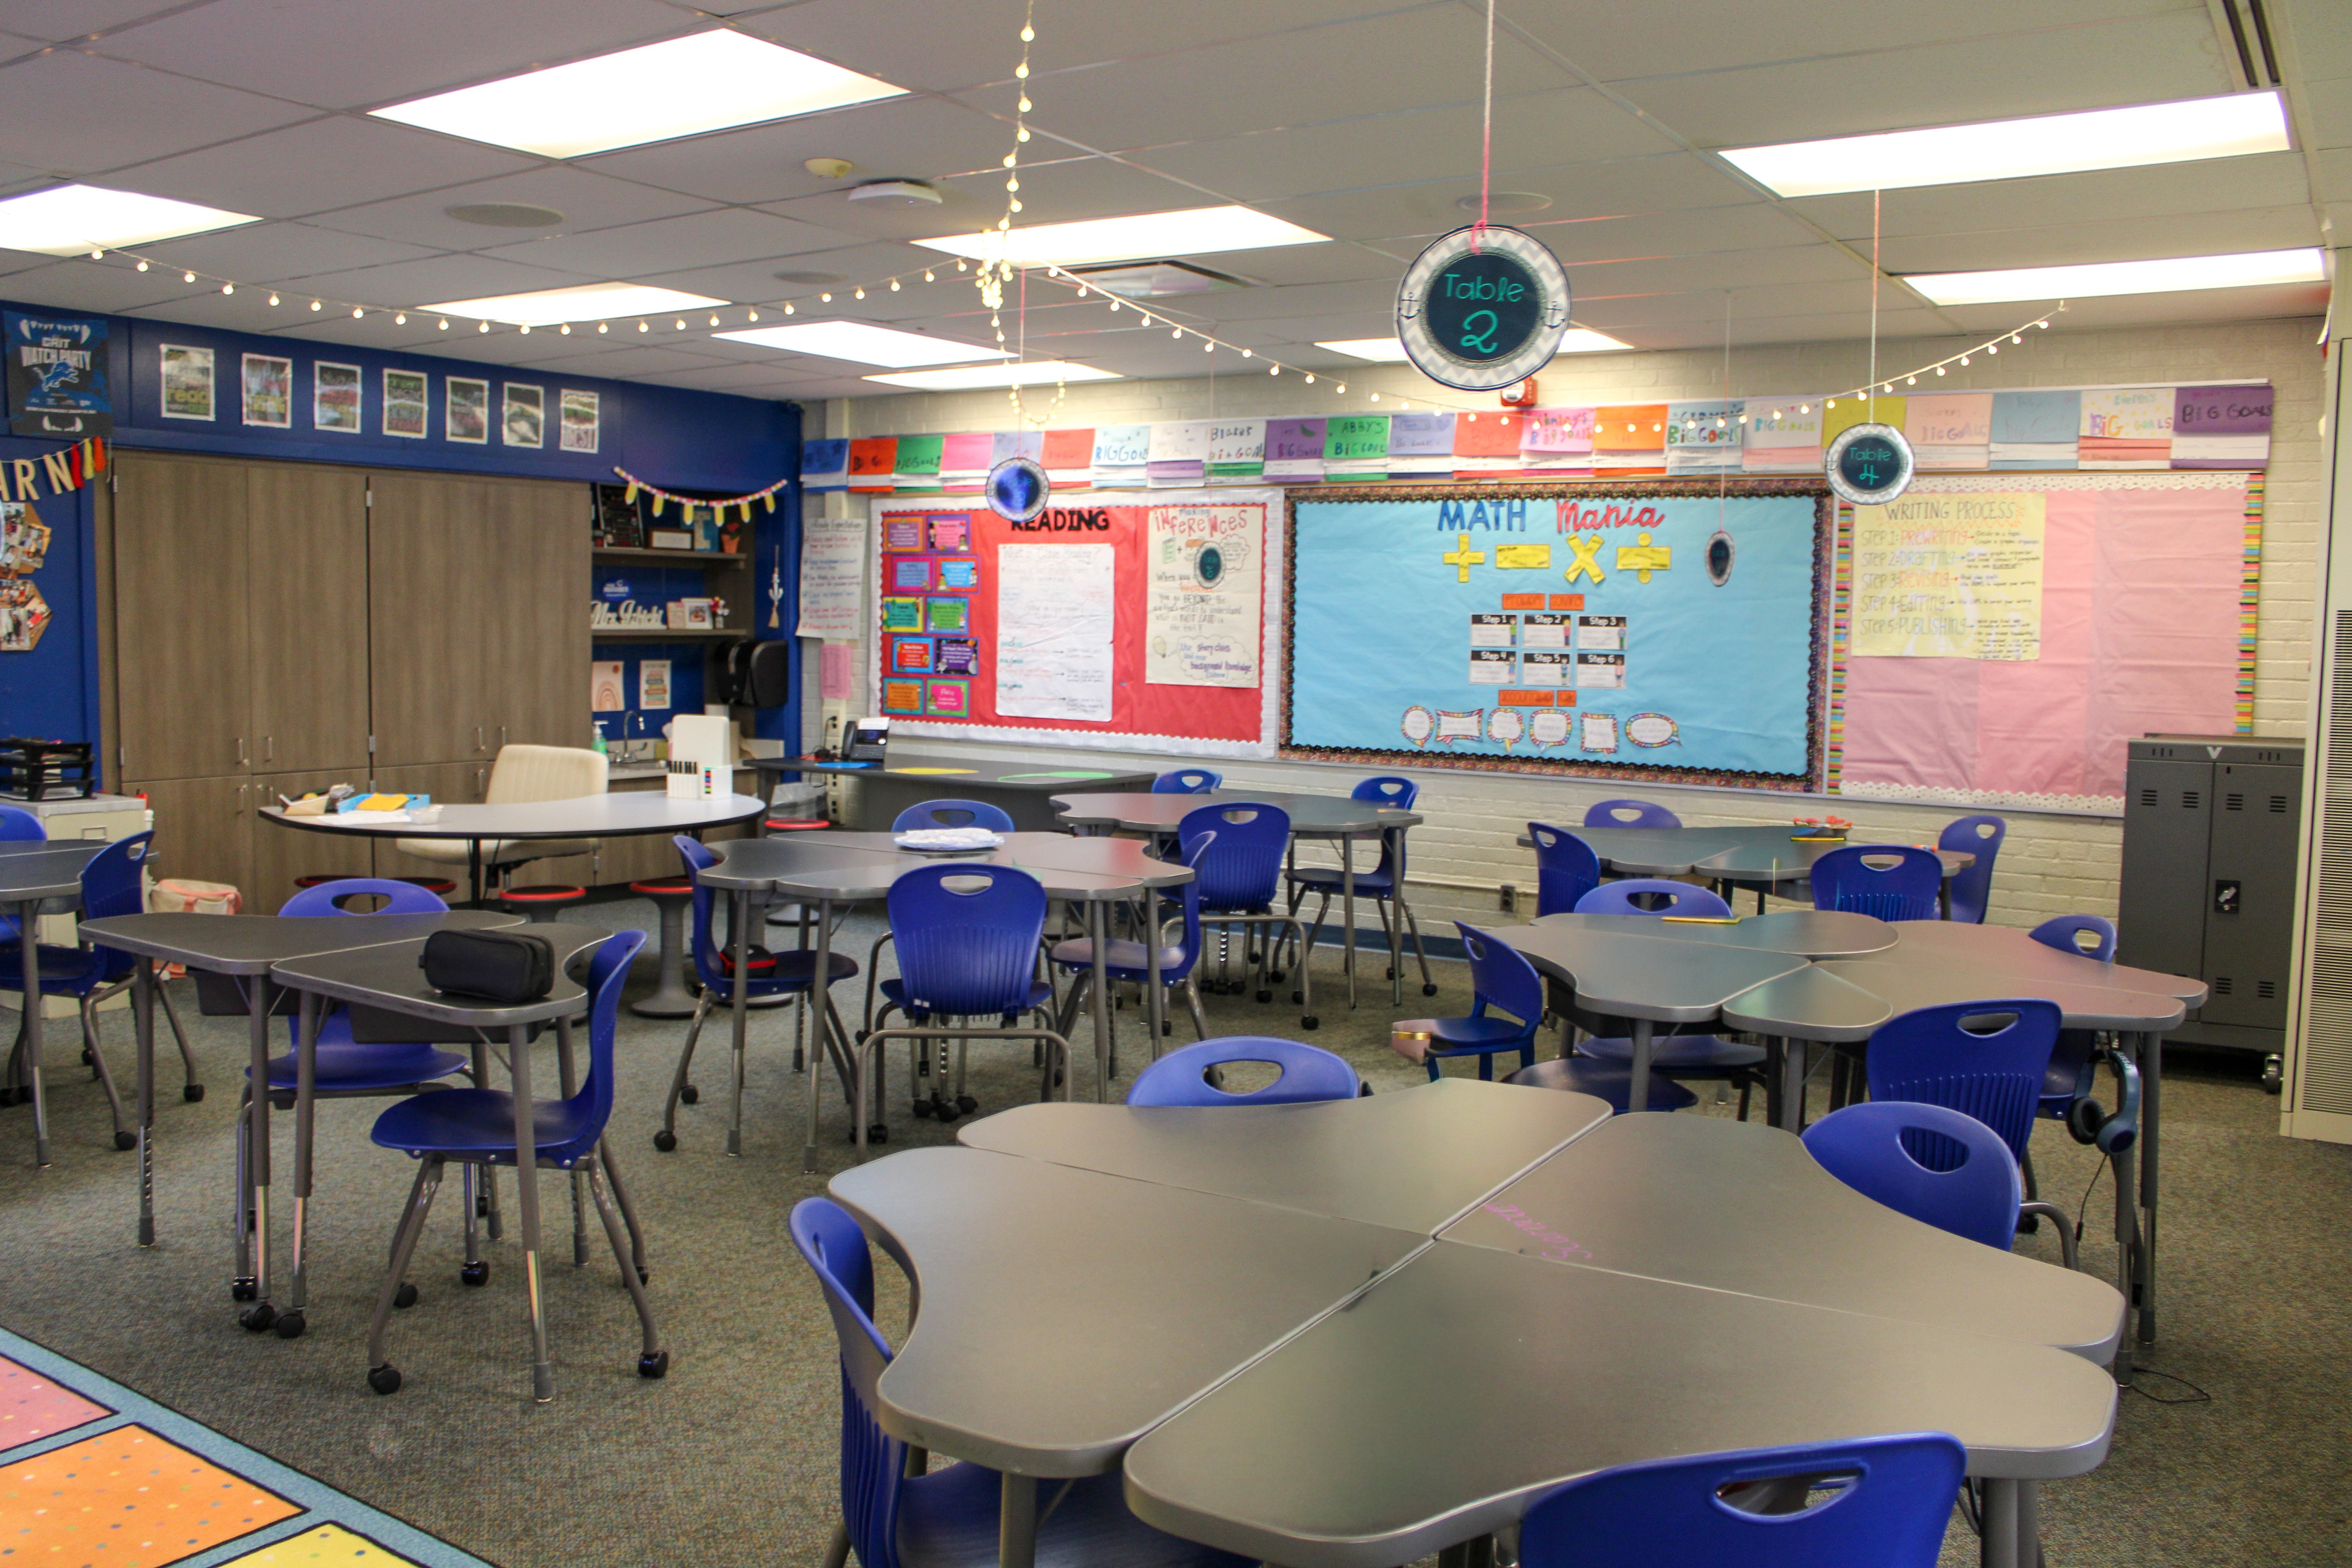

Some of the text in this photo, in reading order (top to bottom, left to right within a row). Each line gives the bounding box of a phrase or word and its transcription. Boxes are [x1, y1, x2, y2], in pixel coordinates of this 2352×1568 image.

[1445, 274, 1524, 302] Table
[1460, 310, 1498, 353] 2
[1849, 447, 1893, 462] Table
[1859, 464, 1880, 486] 4
[1437, 499, 1665, 533] MATH Mania
[1885, 501, 2016, 520] WRITING PROCESS
[1482, 615, 1507, 625] Step 1
[1534, 614, 1561, 625] Step 2
[1589, 617, 1617, 627] Step 3
[1481, 651, 1507, 662] Step 4
[1533, 653, 1561, 664] Step 5
[1587, 654, 1615, 665] Step 6
